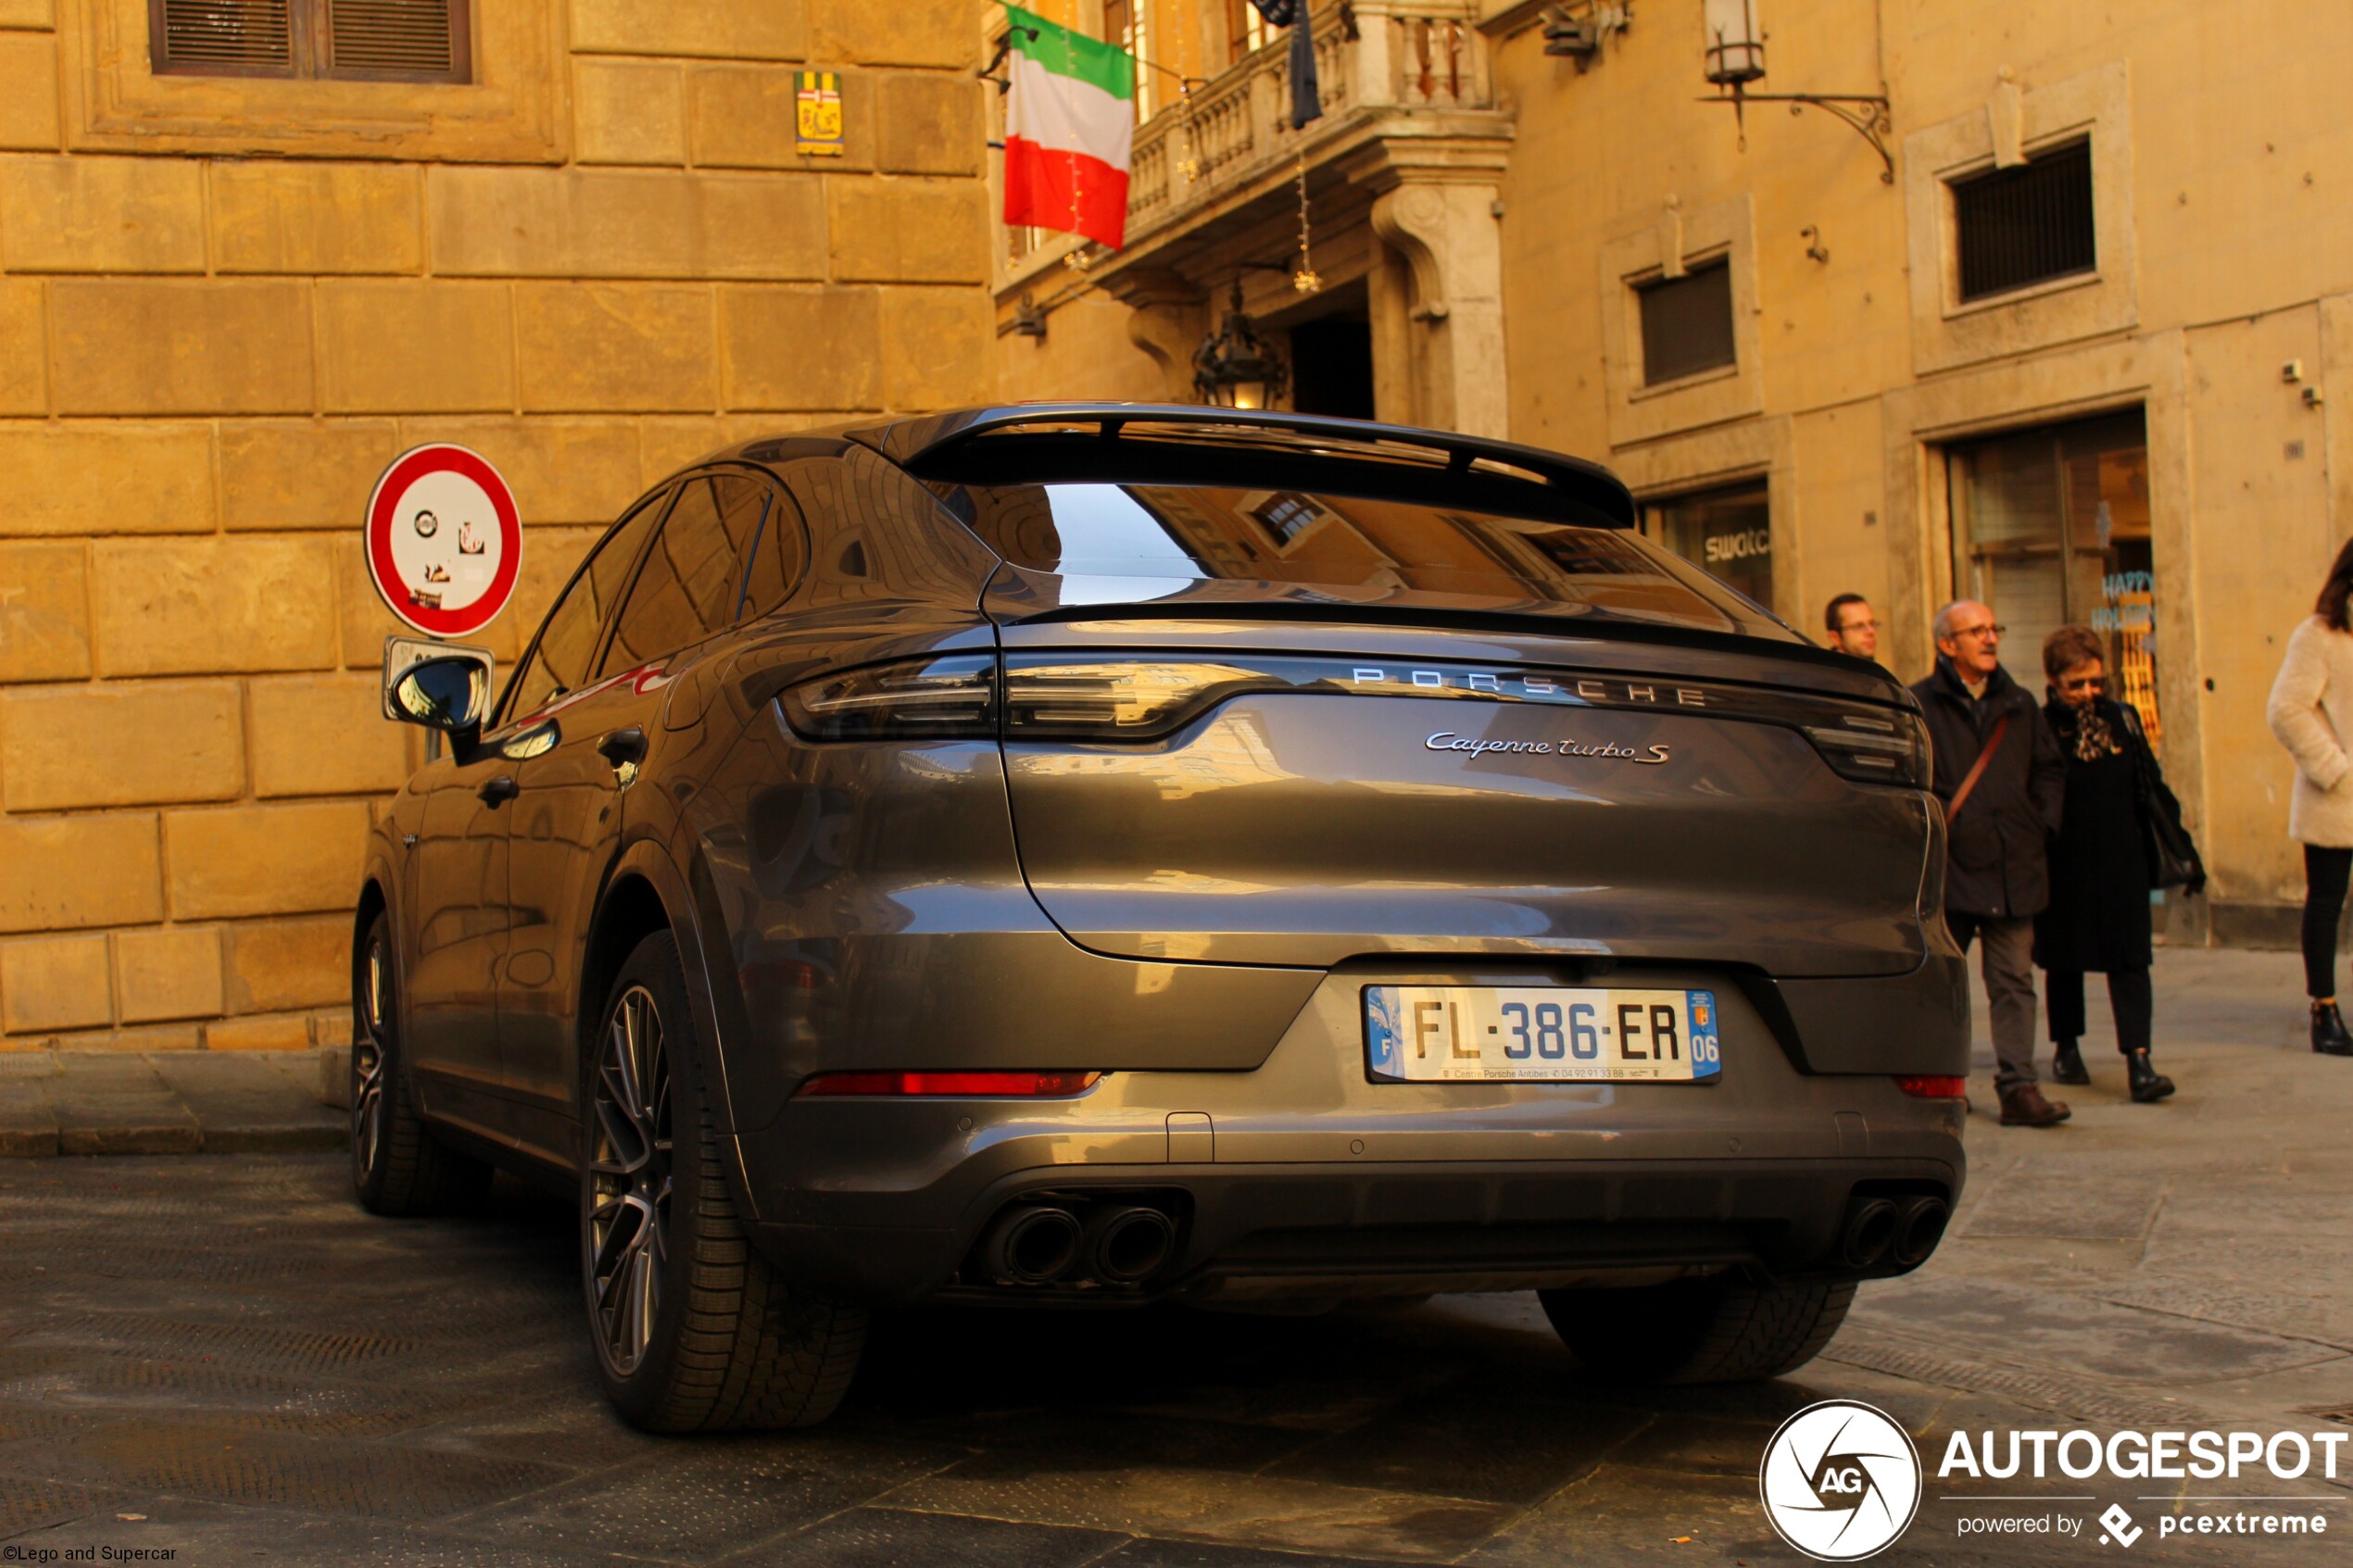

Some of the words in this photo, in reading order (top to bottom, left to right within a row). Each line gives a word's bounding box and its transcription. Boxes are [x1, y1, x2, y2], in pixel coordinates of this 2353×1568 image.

[2101, 571, 2156, 601] HAPPY
[1353, 667, 1705, 708] PORSCHE
[1424, 731, 1553, 759] Cayenne
[1558, 738, 1635, 759] turbo
[1632, 744, 1670, 765] S
[1381, 1038, 1392, 1057] F
[1692, 1034, 1719, 1063] 06
[1483, 1069, 1517, 1079] Porsche
[1517, 1069, 1549, 1079] Antibes
